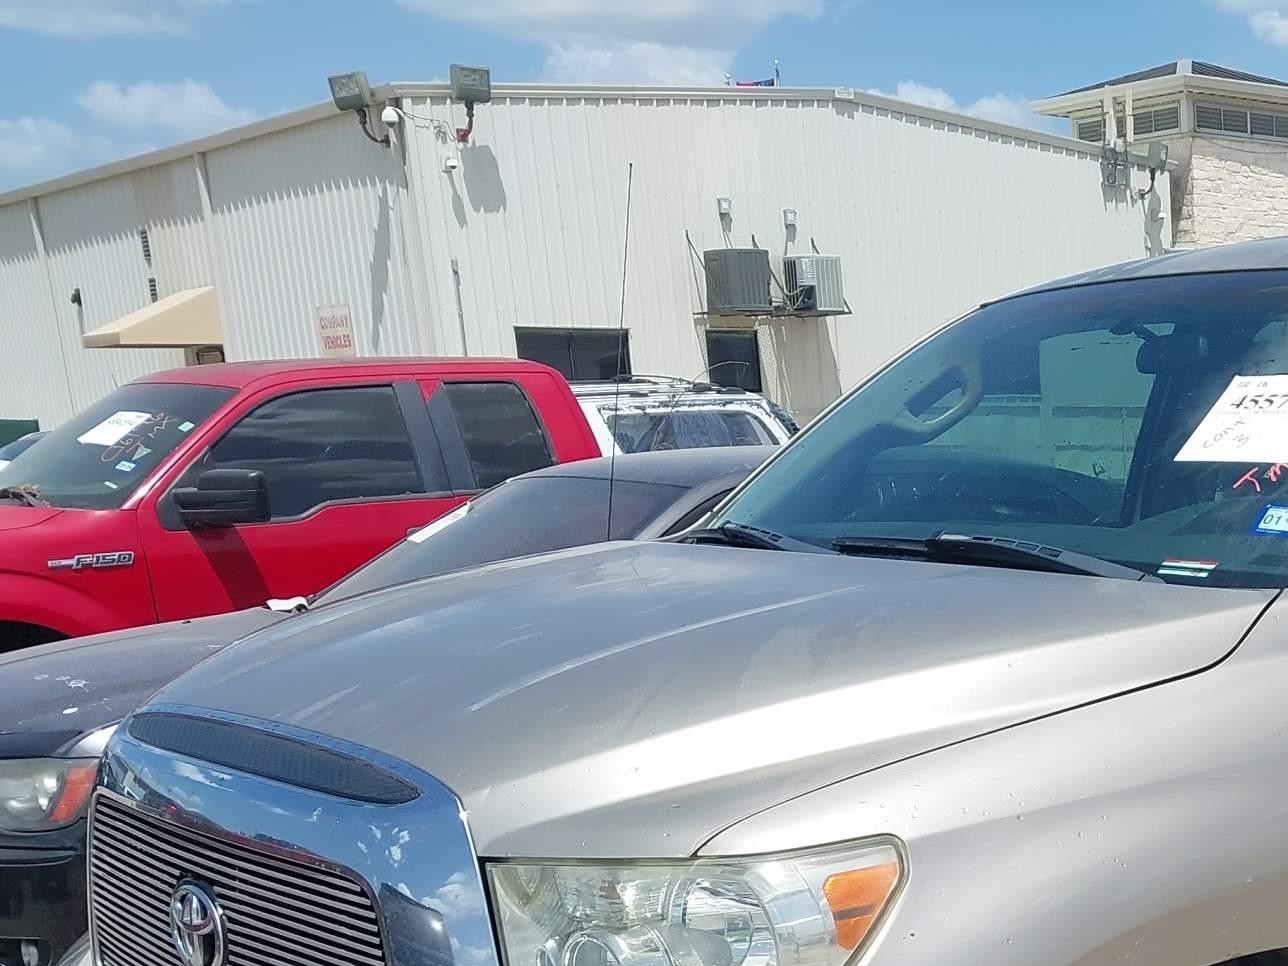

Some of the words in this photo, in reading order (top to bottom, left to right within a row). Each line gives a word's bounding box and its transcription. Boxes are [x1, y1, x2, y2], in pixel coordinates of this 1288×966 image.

[323, 334, 352, 350] VEHICLES
[1262, 514, 1282, 526] 01
[72, 551, 134, 569] F-150
